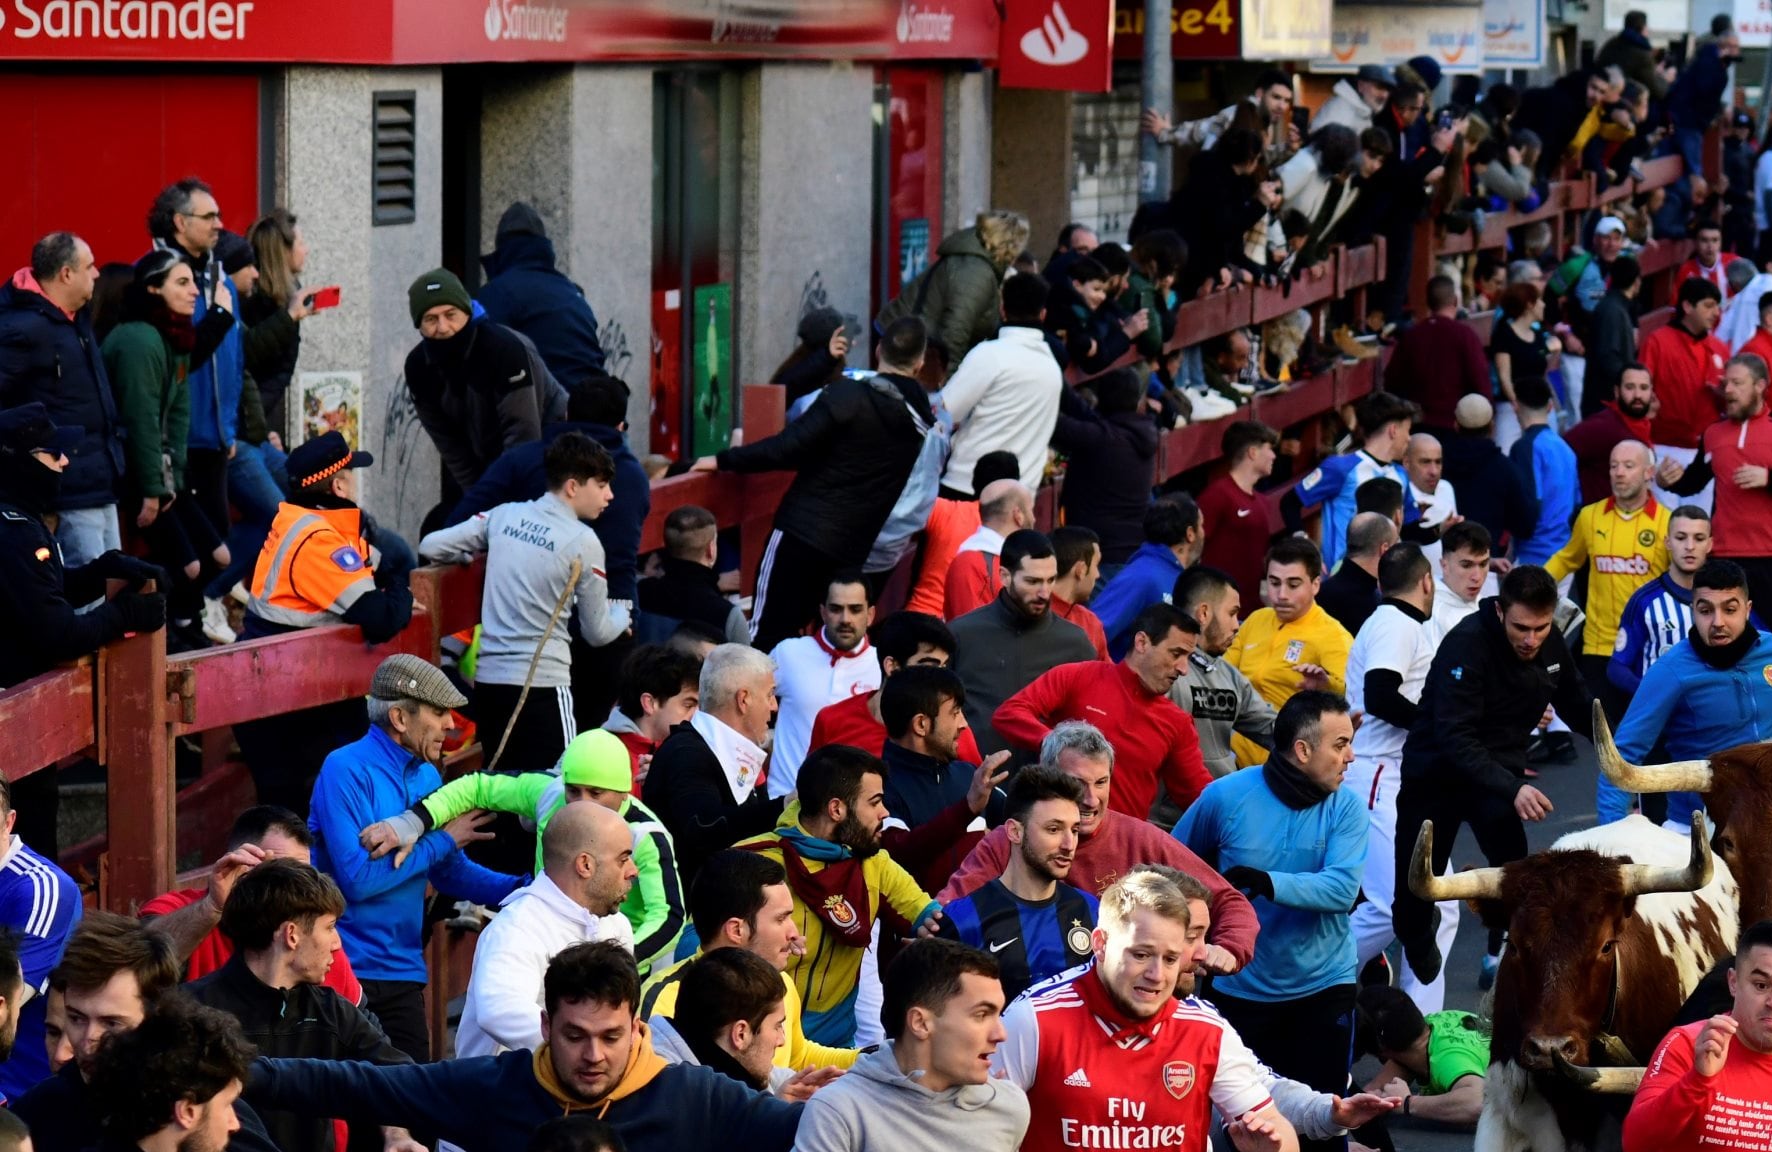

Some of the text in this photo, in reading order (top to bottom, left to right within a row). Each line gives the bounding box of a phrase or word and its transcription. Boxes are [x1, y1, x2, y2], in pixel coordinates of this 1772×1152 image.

[14, 0, 254, 40] Santander
[502, 525, 555, 552] RWANDA
[520, 518, 551, 535] VISIT
[1168, 1067, 1190, 1075] Arsenal
[1063, 1079, 1091, 1088] adidas
[1108, 1097, 1146, 1121] Fly
[1061, 1118, 1186, 1149] Emirates
